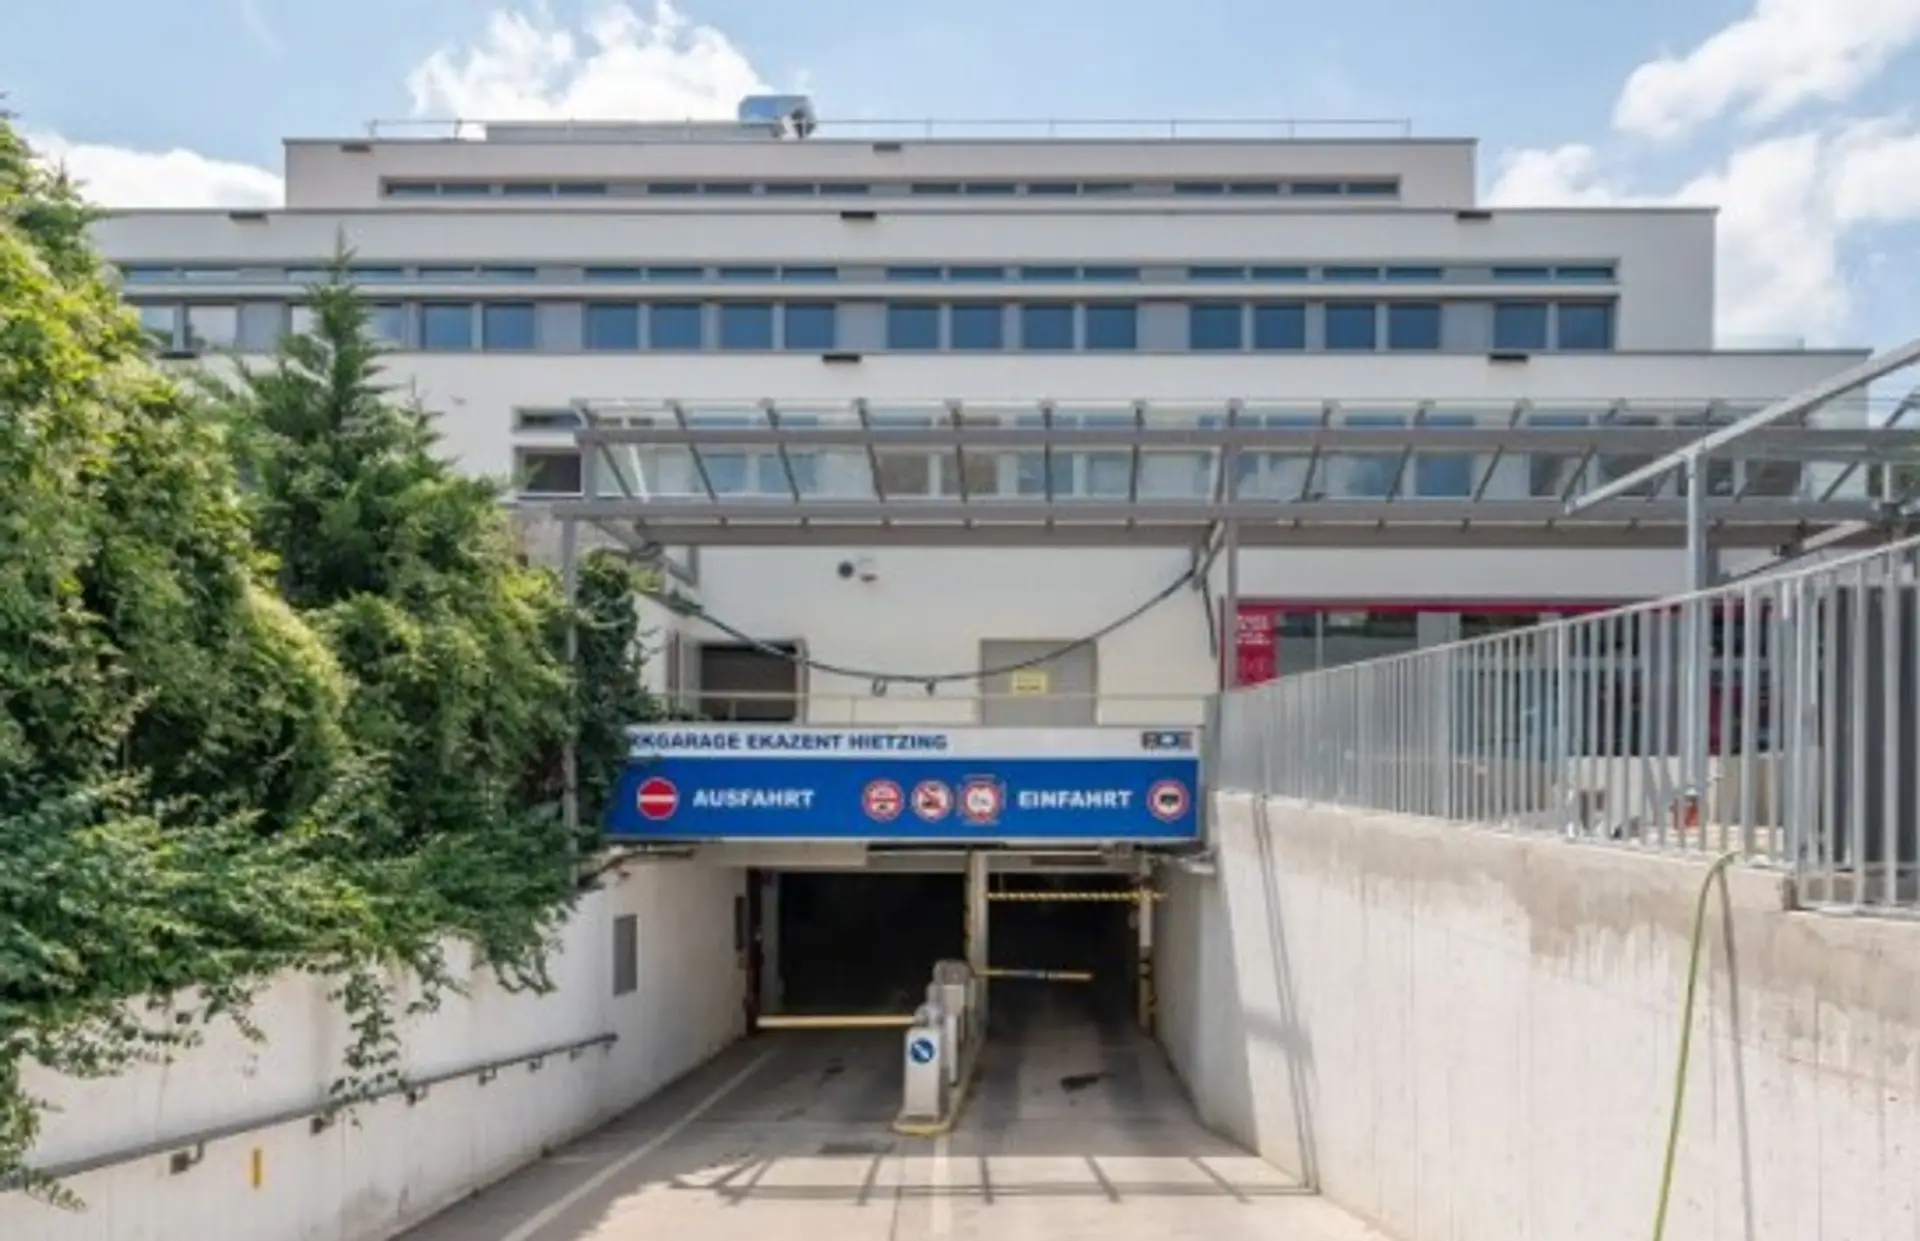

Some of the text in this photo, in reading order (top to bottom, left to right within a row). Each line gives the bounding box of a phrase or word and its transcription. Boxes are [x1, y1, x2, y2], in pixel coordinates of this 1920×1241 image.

[748, 732, 842, 750] EKAZENT
[850, 732, 948, 750] HIETZING
[693, 788, 816, 810] AUSFAHRT
[1017, 788, 1134, 809] EINFAHRT
